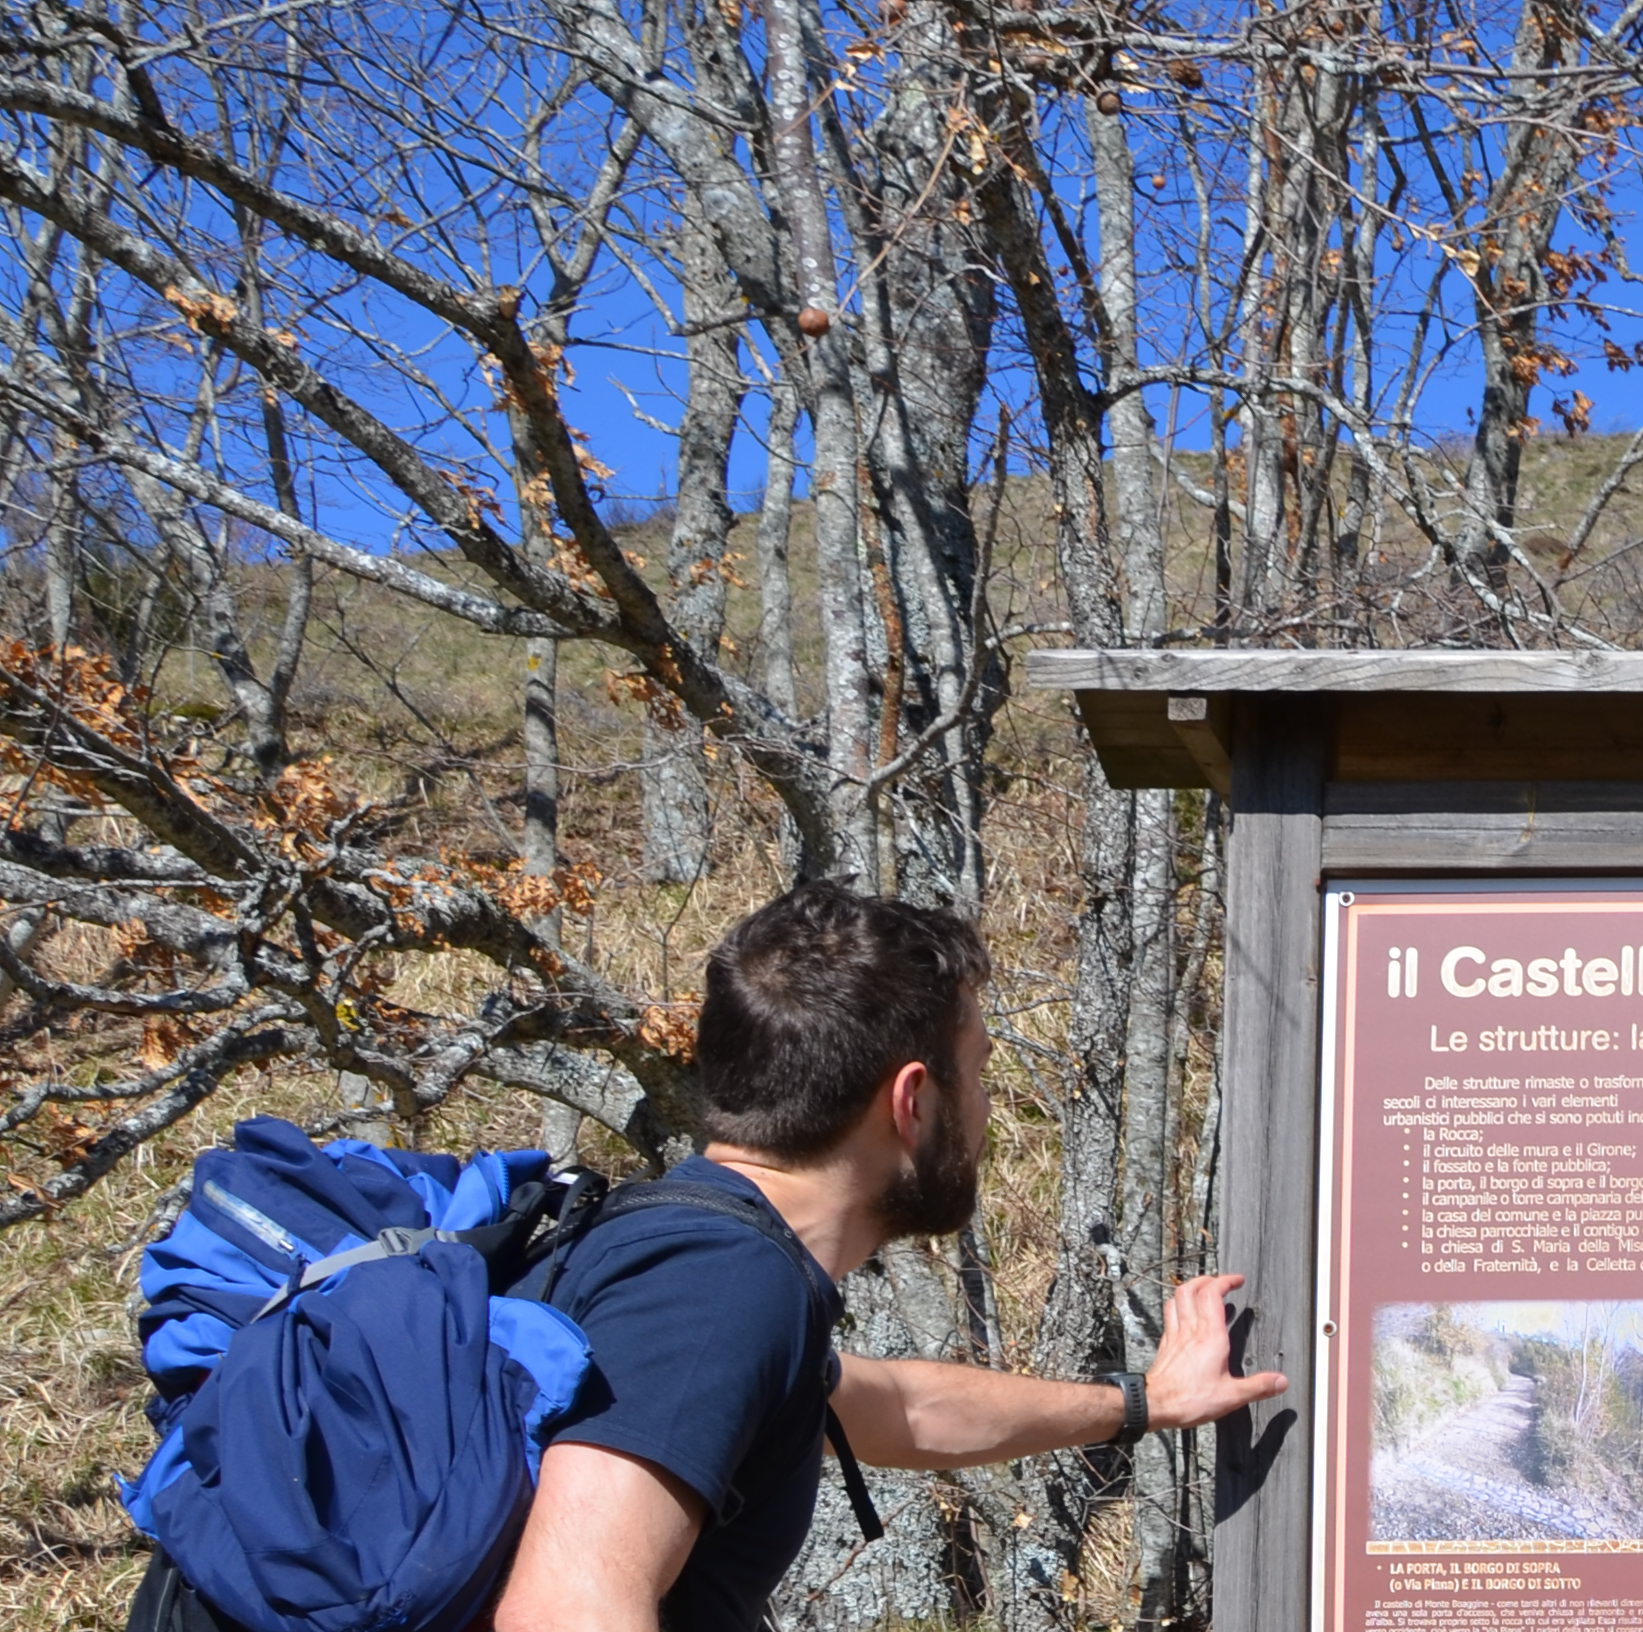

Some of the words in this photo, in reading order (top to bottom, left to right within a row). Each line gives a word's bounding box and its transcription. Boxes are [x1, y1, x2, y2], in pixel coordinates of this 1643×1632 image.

[1387, 946, 1418, 998] il
[1430, 1024, 1468, 1052] Le
[1478, 1024, 1619, 1051] strutture:
[1424, 1075, 1458, 1090] Delle
[1462, 1076, 1520, 1090] strutture
[1524, 1075, 1575, 1089] rimaste
[1383, 1095, 1420, 1109] secoli
[1441, 1094, 1517, 1108] interessano
[1531, 1093, 1556, 1107] vari
[1561, 1093, 1618, 1107] elementi
[1383, 1111, 1449, 1126] urbanistici
[1453, 1110, 1504, 1127] pubblici
[1507, 1110, 1532, 1124] che
[1549, 1113, 1582, 1124] sono
[1585, 1110, 1624, 1127] potuti
[1439, 1126, 1483, 1143] Rocca;
[1433, 1143, 1484, 1157] circuito
[1486, 1143, 1519, 1157] delle
[1523, 1145, 1559, 1157] mura
[1586, 1142, 1636, 1158] Girone;
[1433, 1159, 1482, 1173] fossato
[1512, 1158, 1548, 1172] fonte
[1551, 1158, 1611, 1175] pubblica;
[1437, 1176, 1475, 1192] porta,
[1489, 1175, 1529, 1191] borgo
[1546, 1177, 1583, 1191] sopra
[1431, 1191, 1497, 1207] campanile
[1512, 1190, 1544, 1205] torre
[1546, 1190, 1622, 1207] campanaria
[1624, 1190, 1643, 1204] del
[1436, 1211, 1467, 1222] casa
[1470, 1207, 1491, 1222] del
[1494, 1210, 1549, 1222] comune
[1580, 1207, 1622, 1223] piazza
[1436, 1224, 1477, 1238] chiesa
[1480, 1223, 1558, 1240] parrocchiale
[1582, 1223, 1639, 1240] contiguo
[1440, 1239, 1483, 1254] chiesa
[1533, 1239, 1571, 1253] Maria
[1578, 1238, 1610, 1253] della
[1433, 1258, 1465, 1272] della
[1473, 1257, 1541, 1274] Fraternità,
[1586, 1257, 1636, 1271] Celletta
[1389, 1562, 1404, 1574] LA
[1406, 1562, 1447, 1576] PORTA,
[1449, 1562, 1461, 1574] IL
[1463, 1562, 1504, 1574] BORGO
[1506, 1562, 1520, 1574] DI
[1522, 1561, 1560, 1574] SOPRA
[1389, 1578, 1402, 1593] (o
[1403, 1578, 1422, 1590] Via
[1423, 1578, 1459, 1592] Piana)
[1461, 1578, 1469, 1589] E
[1471, 1578, 1483, 1590] IL
[1485, 1578, 1525, 1590] BORGO
[1527, 1577, 1541, 1589] DI
[1543, 1577, 1581, 1590] SOTTO
